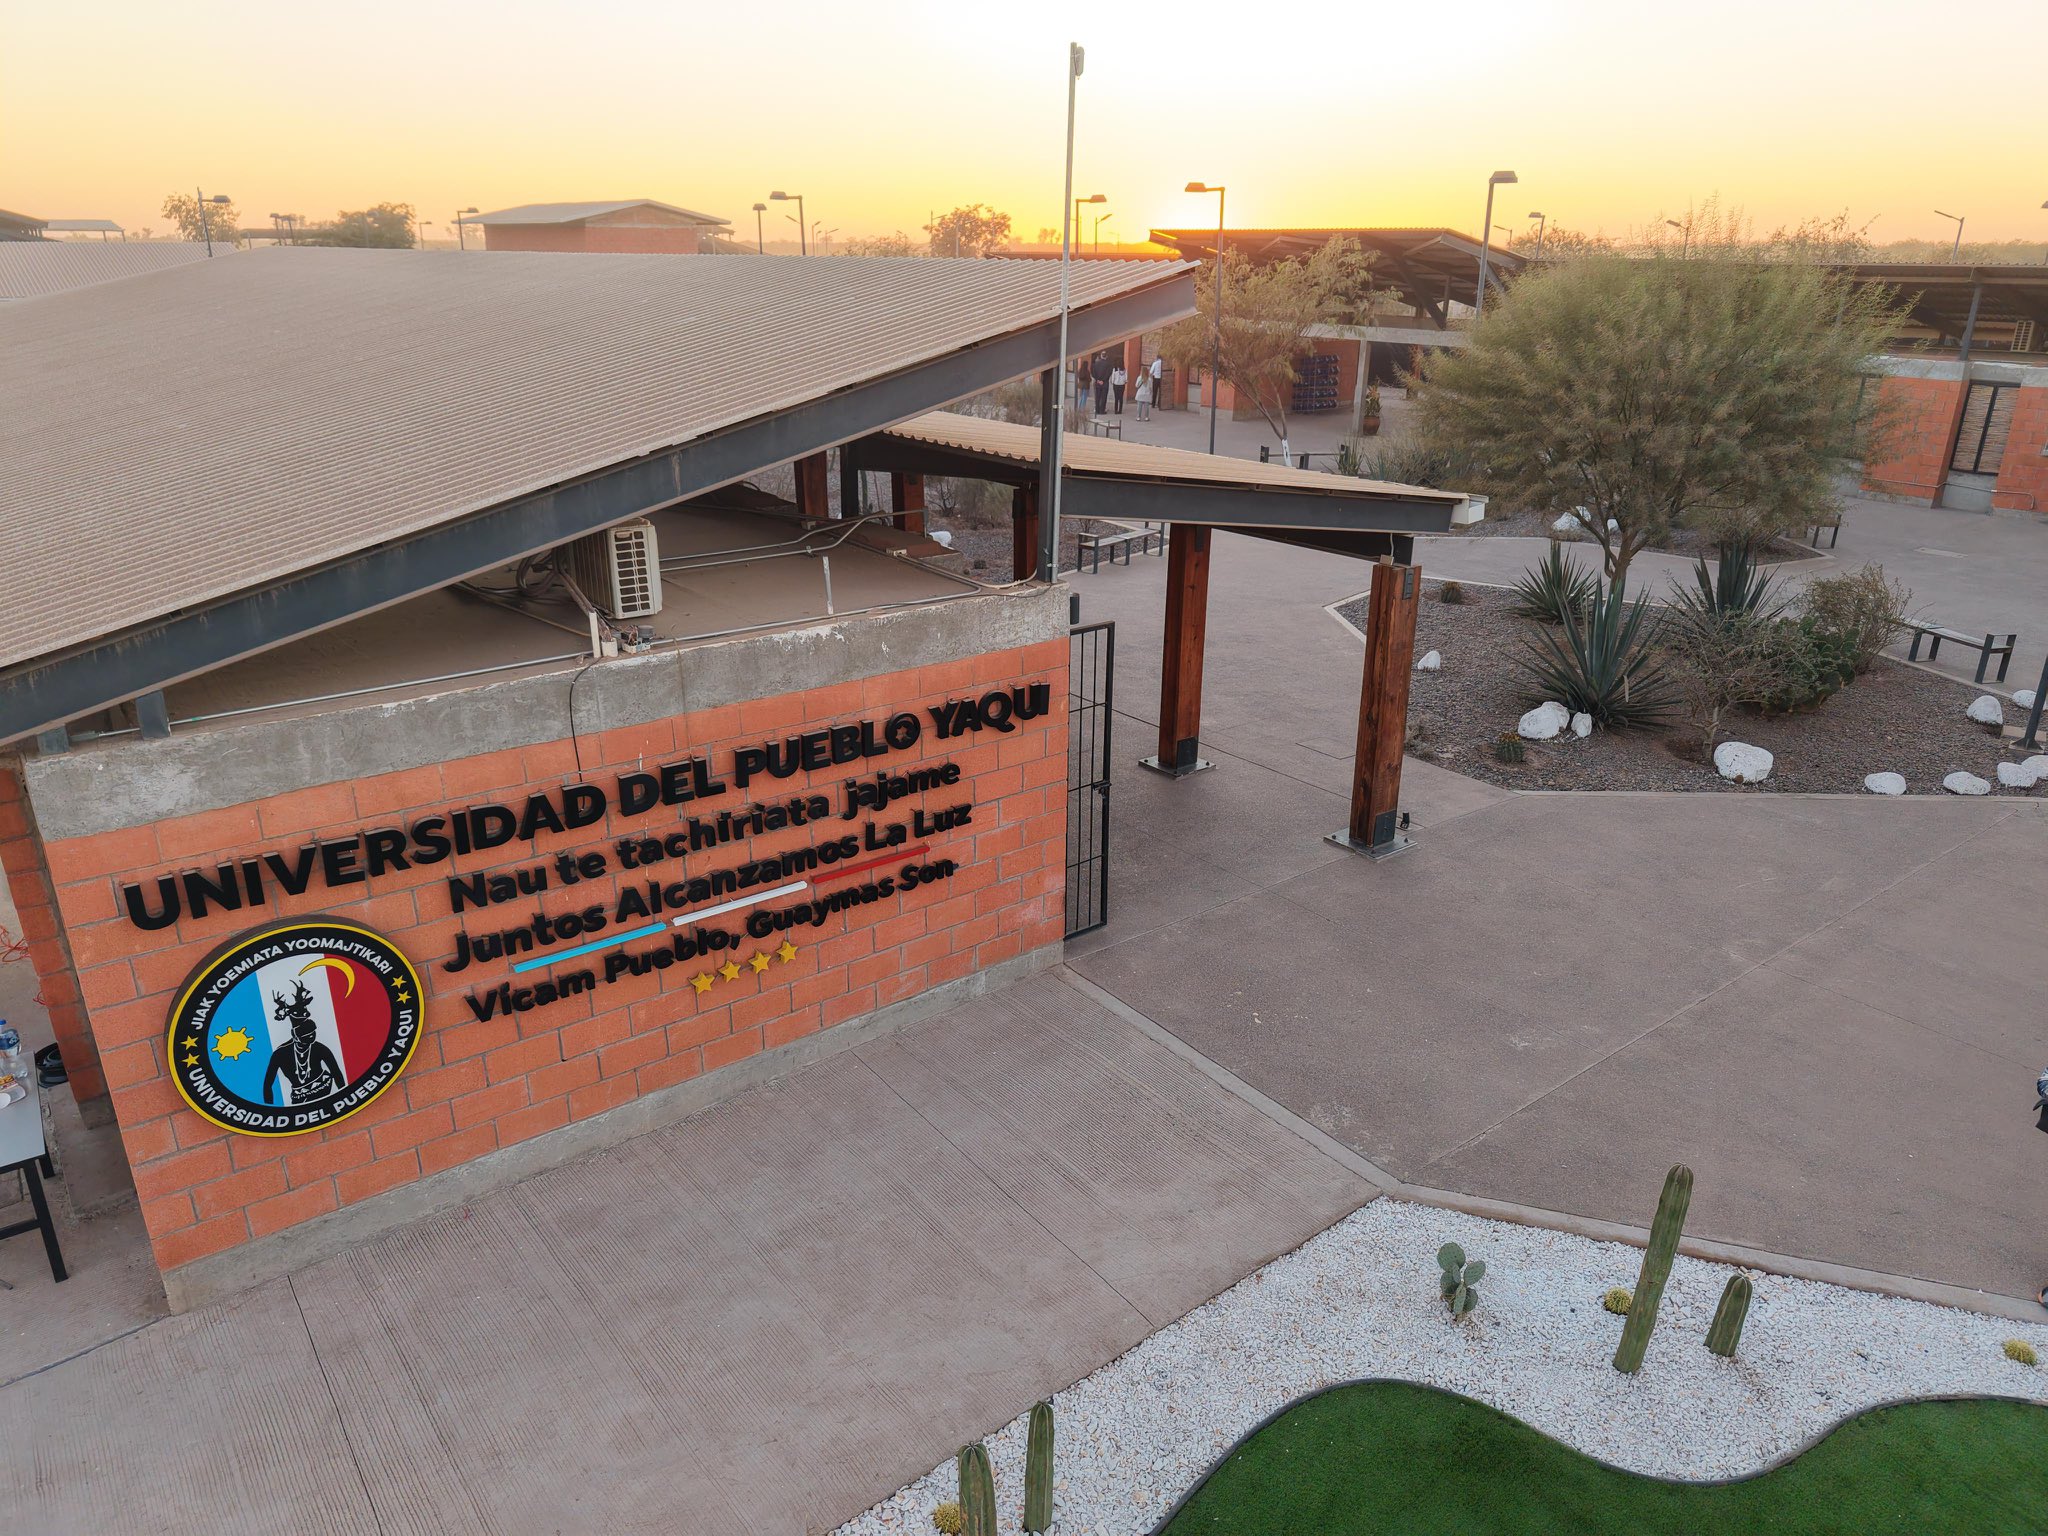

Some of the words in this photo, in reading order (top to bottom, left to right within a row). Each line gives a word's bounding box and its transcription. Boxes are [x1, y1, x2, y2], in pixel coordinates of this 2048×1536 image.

[123, 783, 607, 930] UNIVERSIDAD
[617, 756, 727, 818] DEL
[734, 712, 921, 789] PUEBLO
[928, 682, 1050, 740] YAQUI
[448, 865, 548, 913] Nau
[555, 851, 607, 885] te
[842, 762, 961, 820] jajame
[443, 904, 607, 973] Juntos
[616, 835, 860, 924] Alcanzamos
[865, 821, 907, 852] La
[913, 803, 973, 838] Luz
[604, 926, 741, 984] Pueblo,
[747, 876, 895, 940] Guaymas
[190, 996, 215, 1031] JIAK
[207, 945, 283, 997] YOEMIATA
[284, 937, 393, 975] YOOMAJTIKARI
[188, 1067, 289, 1128] UNIVERSIDAD
[294, 1109, 331, 1127] DEL
[334, 1062, 393, 1113] PUEBLO
[388, 1009, 414, 1058] YAQUI
